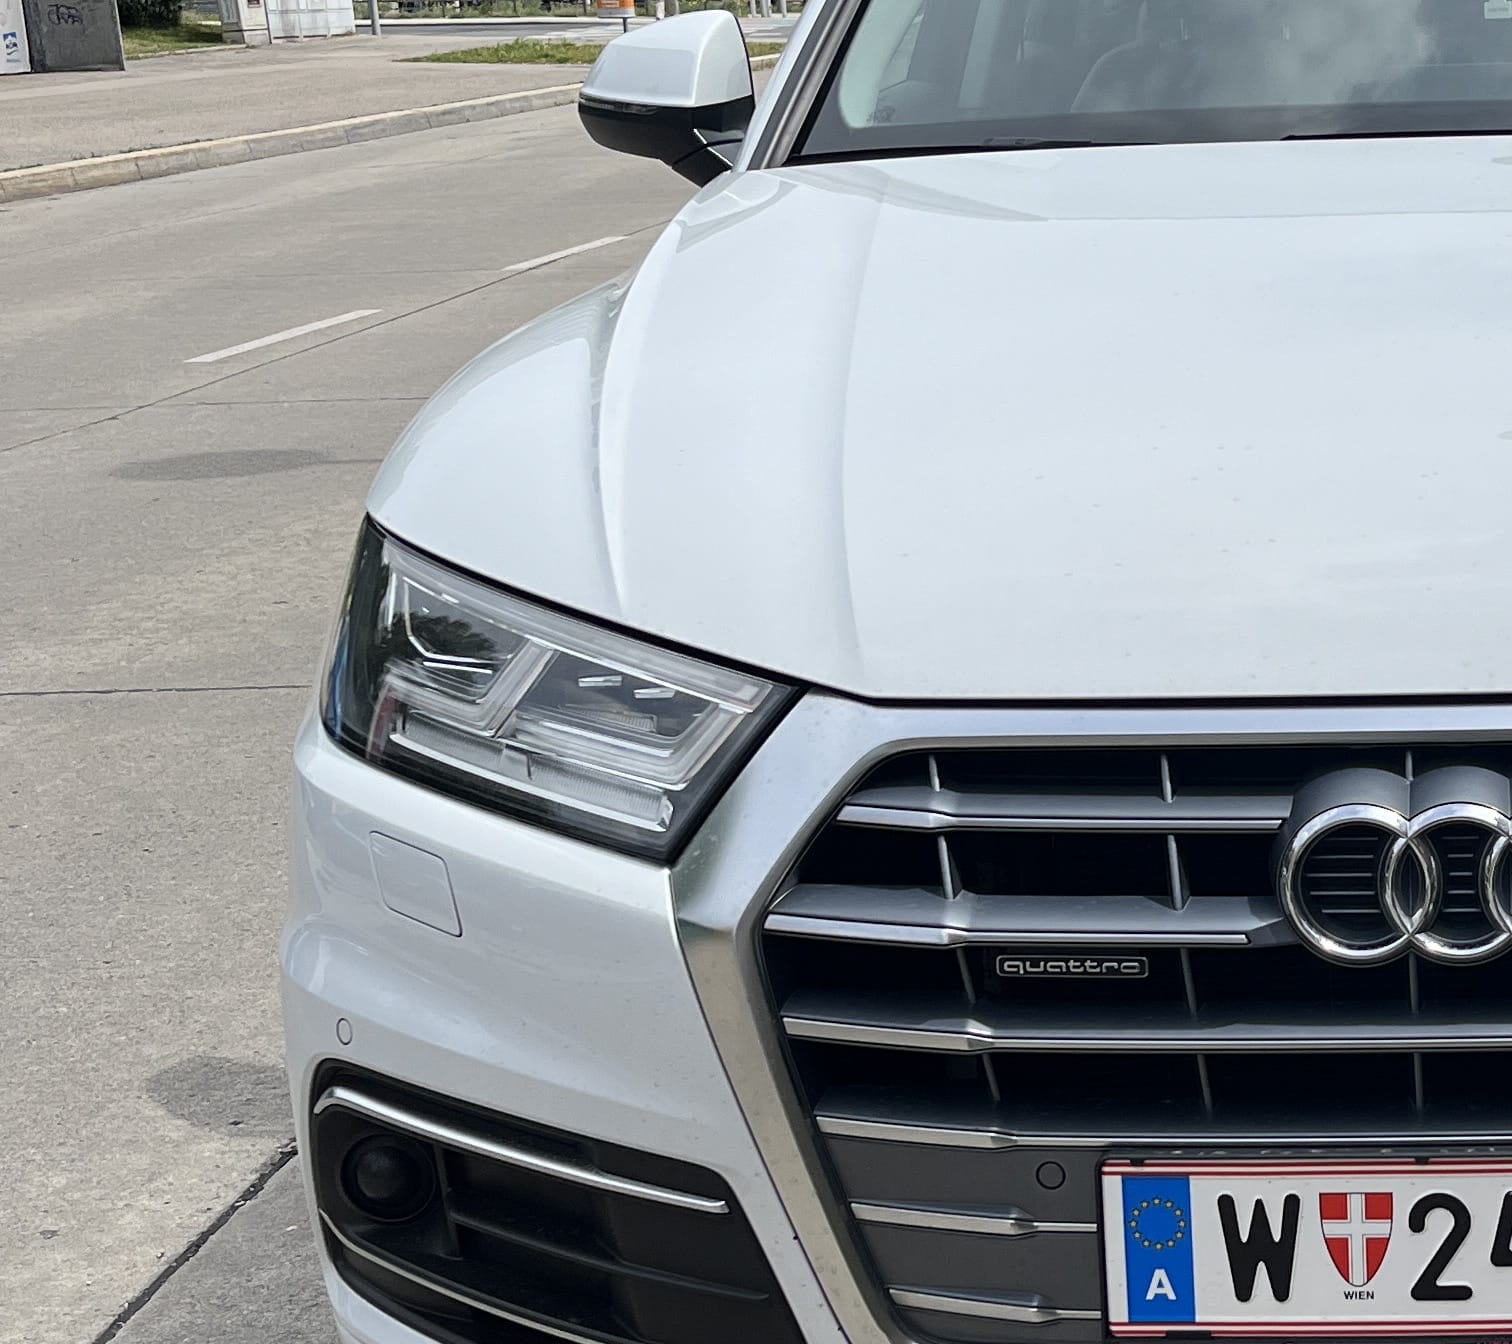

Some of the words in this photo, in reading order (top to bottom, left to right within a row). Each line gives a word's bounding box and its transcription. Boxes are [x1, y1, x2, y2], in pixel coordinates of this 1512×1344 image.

[1003, 959, 1140, 975] quattro
[1145, 1268, 1177, 1301] A
[1217, 1193, 1301, 1303] W
[1343, 1290, 1375, 1301] WIEN
